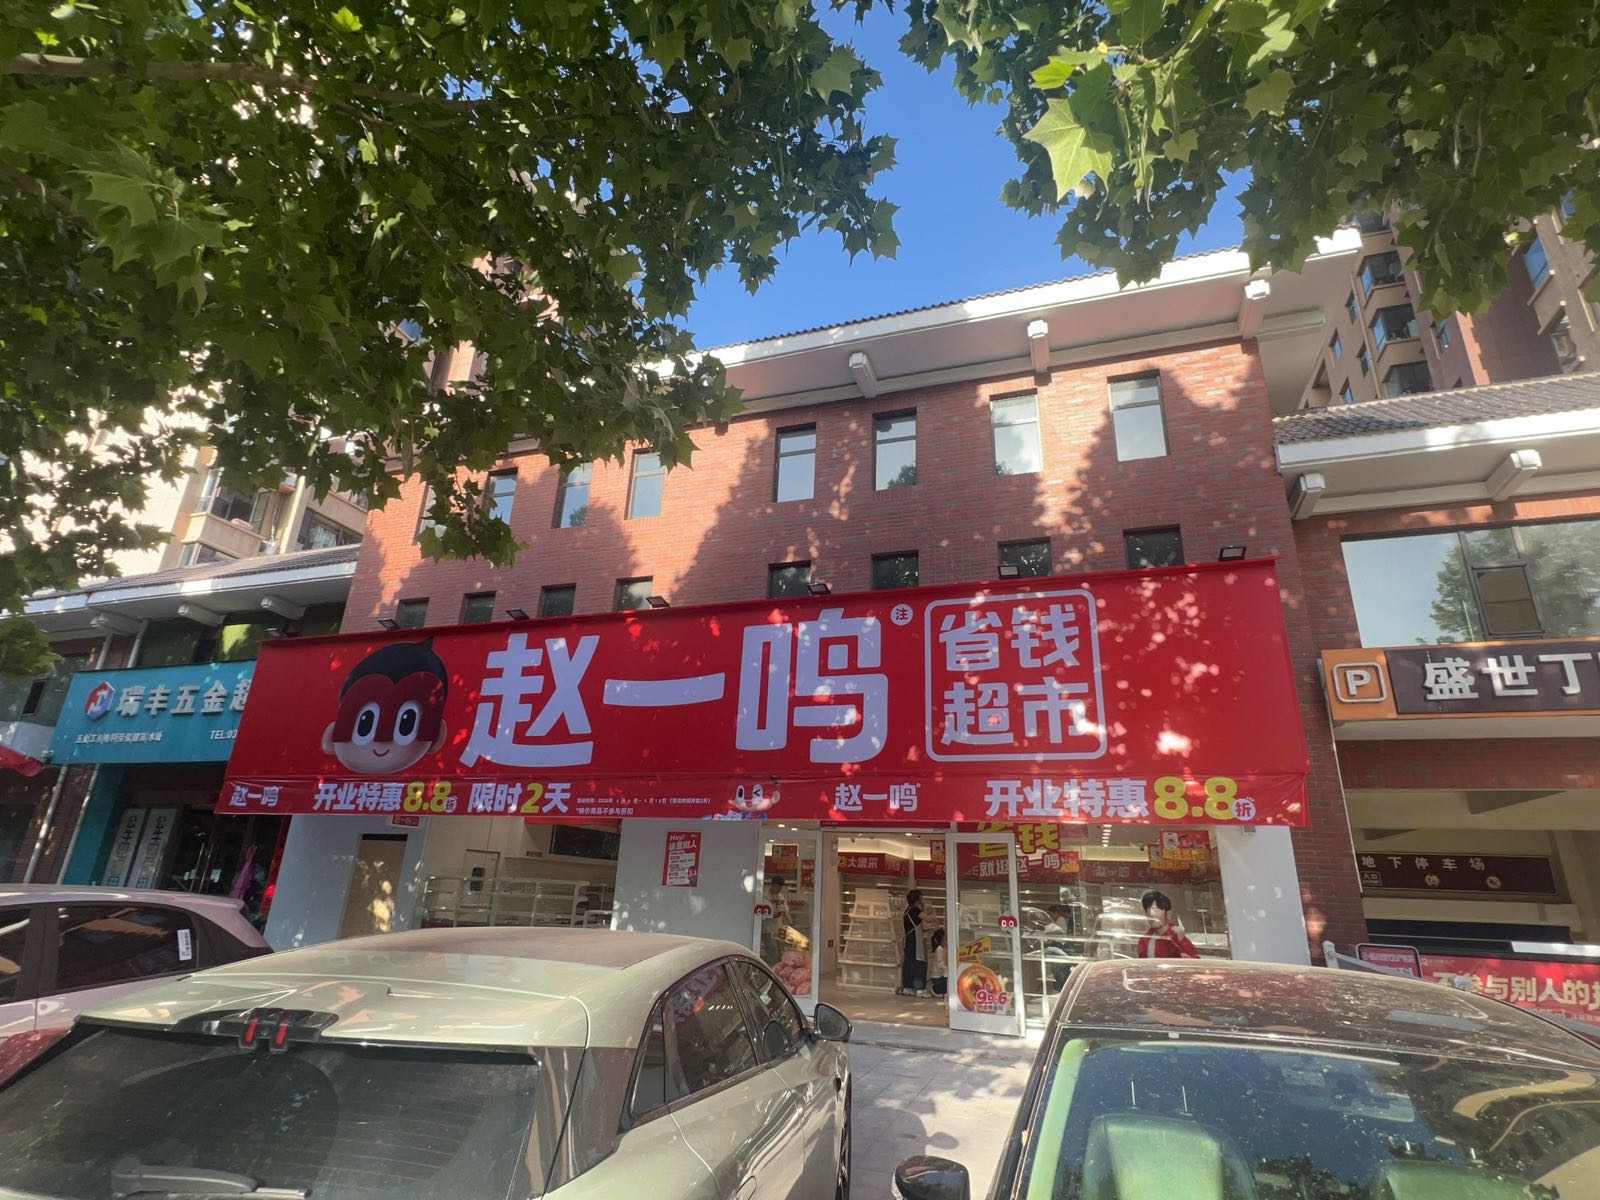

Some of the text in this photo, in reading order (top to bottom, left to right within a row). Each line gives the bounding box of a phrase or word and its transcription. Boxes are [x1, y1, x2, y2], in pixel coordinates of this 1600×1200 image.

[938, 602, 1081, 673] 省钱
[459, 606, 889, 768] 赵一鸣
[1344, 667, 1371, 697] P
[1423, 652, 1600, 701] 盛世丁
[940, 676, 1089, 747] 超市
[229, 785, 283, 807] 赵一鸣
[467, 782, 572, 814] 限时2天
[835, 782, 918, 812] 赵一鸣
[1360, 855, 1486, 871] 地下停车场
